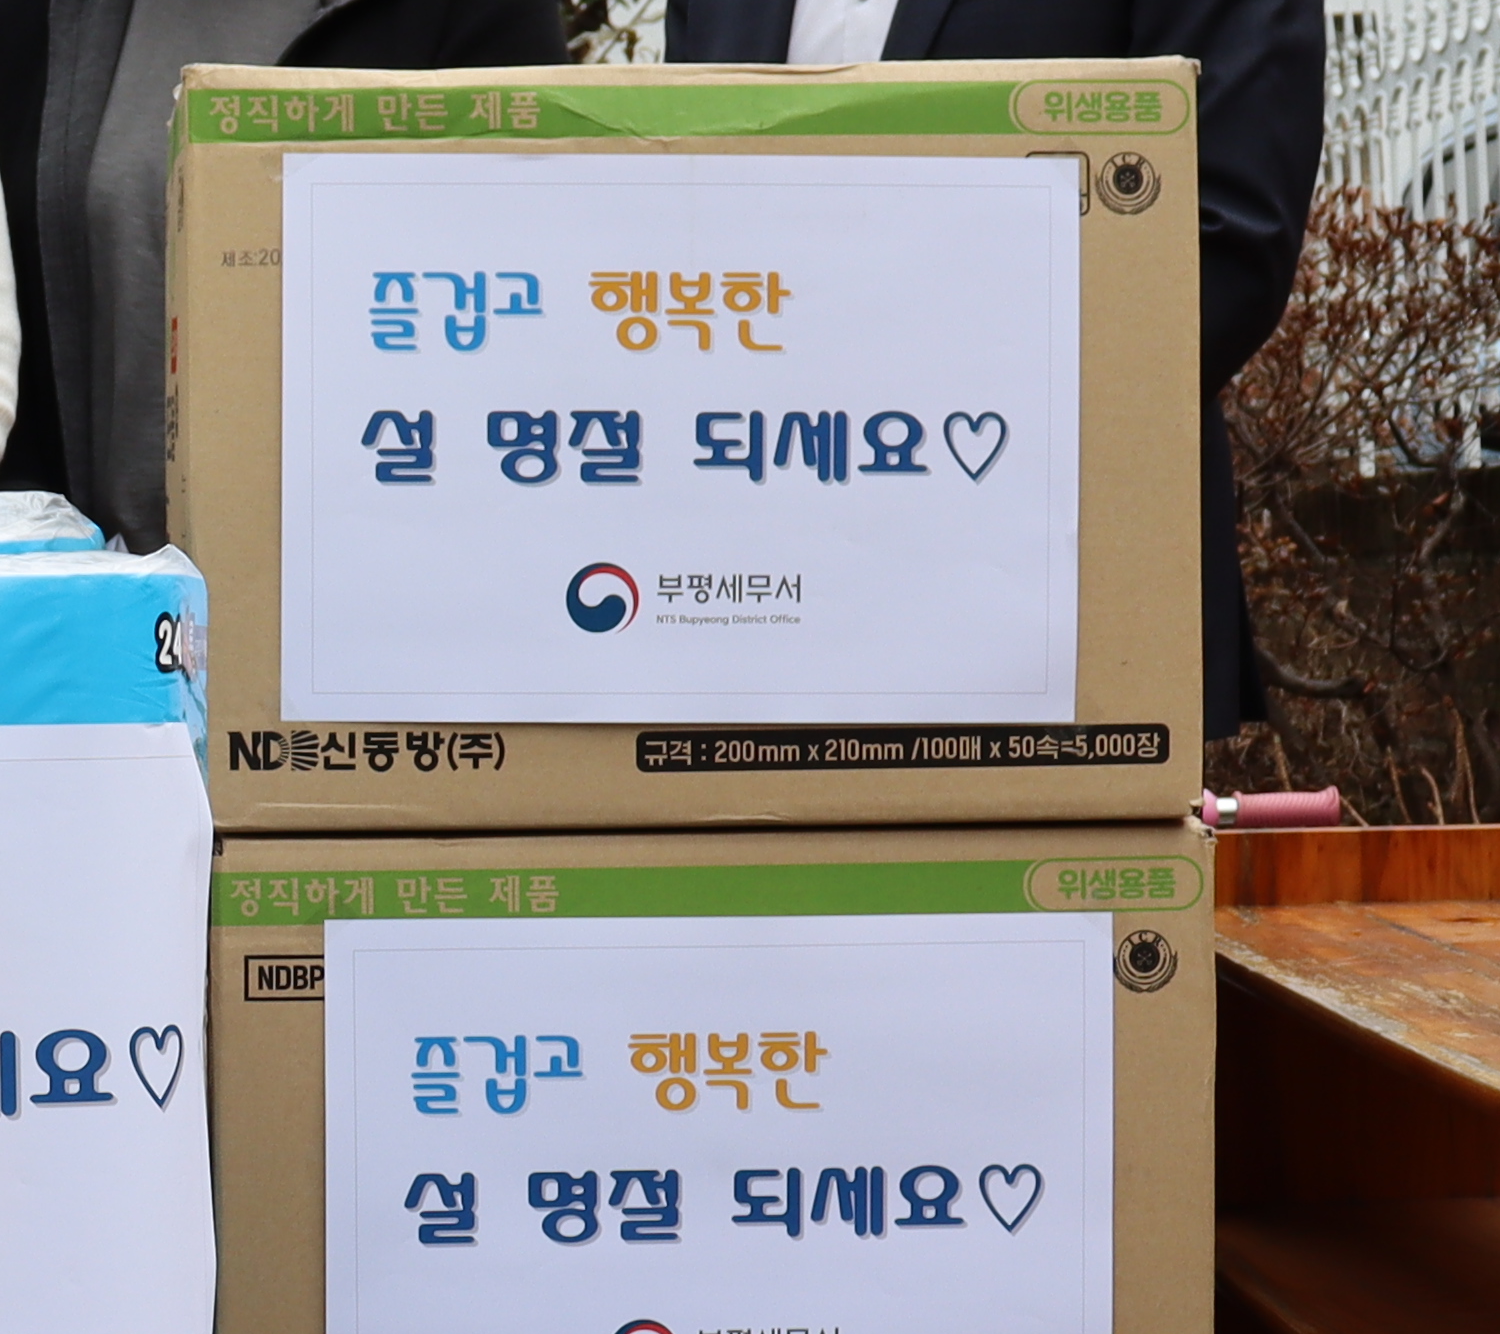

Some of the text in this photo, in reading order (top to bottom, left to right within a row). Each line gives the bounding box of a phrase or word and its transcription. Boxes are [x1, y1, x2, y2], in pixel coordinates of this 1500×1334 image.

[210, 91, 541, 134] 정직하게 만든 제품
[1044, 90, 1162, 125] 위생용품
[369, 270, 793, 353] 즐겁고 행복한
[360, 411, 435, 484] 설
[487, 409, 643, 485] 명절
[657, 573, 801, 604] 부평세무서
[657, 614, 801, 626] NTS Bupyeong District Office
[643, 740, 692, 767] 규격
[715, 739, 800, 763] 200mm
[825, 737, 904, 763] 210mm
[230, 875, 559, 917] 정직하게 만든 제품
[1056, 865, 1176, 901] 위생용품
[410, 1031, 829, 1116] 즐겁고 행복한
[404, 1170, 480, 1246] 설
[527, 1168, 682, 1246] 명절
